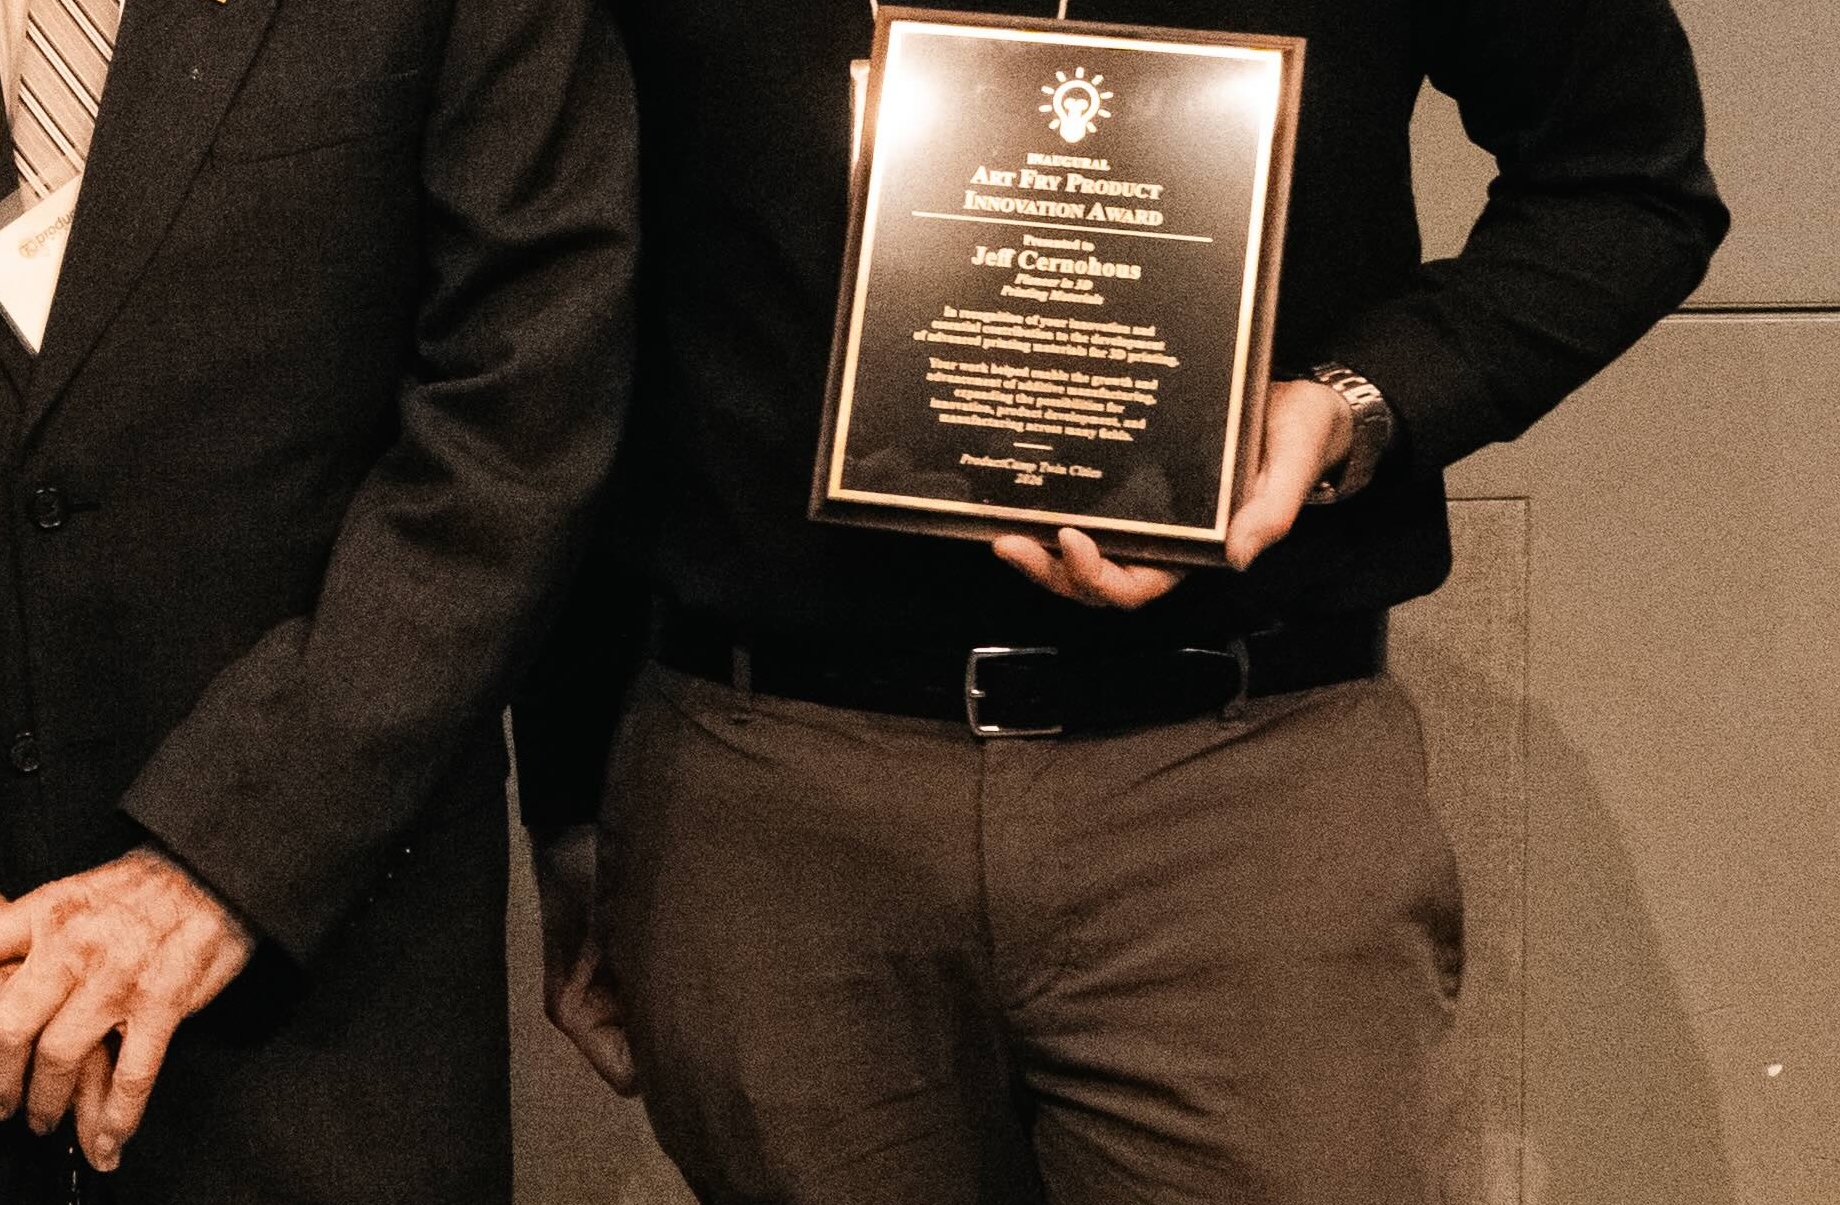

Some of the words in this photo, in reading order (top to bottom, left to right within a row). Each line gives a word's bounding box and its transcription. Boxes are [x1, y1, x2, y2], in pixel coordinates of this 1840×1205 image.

[970, 165, 1016, 187] ART
[1019, 168, 1061, 191] FRY
[1065, 173, 1163, 200] PRODUCT
[963, 190, 1086, 218] INNOVATION
[1087, 202, 1163, 226] AWARD
[971, 246, 1016, 268] Jeff
[1018, 250, 1141, 280] Cernohous
